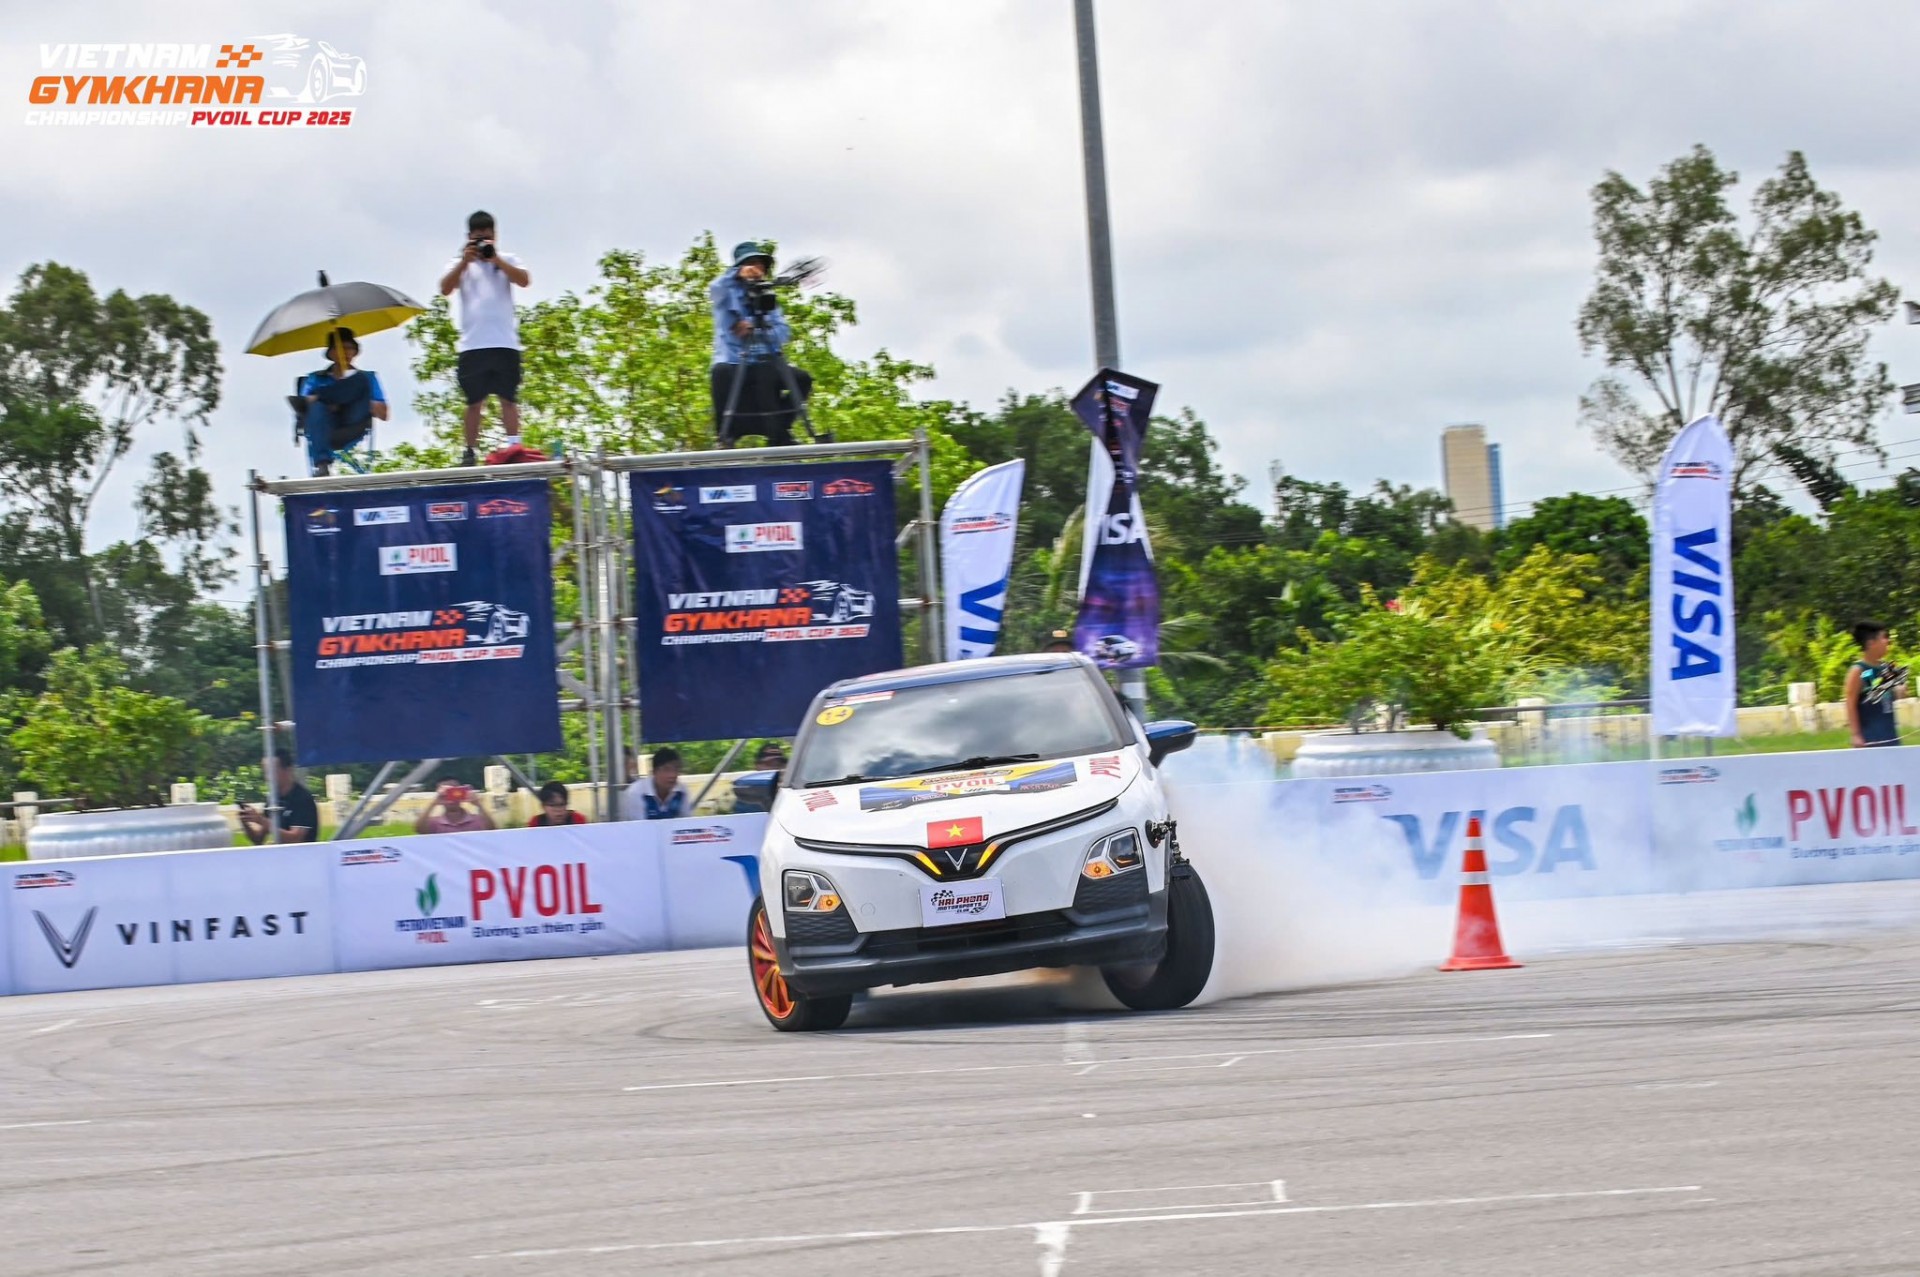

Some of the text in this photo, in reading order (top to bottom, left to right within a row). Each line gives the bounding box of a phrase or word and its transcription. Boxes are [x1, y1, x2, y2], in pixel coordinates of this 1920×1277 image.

[1100, 513, 1143, 545] ISA
[668, 589, 779, 609] VIETNAM
[1671, 528, 1722, 680] VISA
[322, 610, 433, 632] VIETNAM
[663, 607, 812, 632] GYMKHANA
[959, 572, 1008, 657] VI
[318, 628, 466, 656] GYMKHANA
[661, 632, 765, 645] CHAMPIONSHIP
[808, 628, 835, 638] CUP
[315, 654, 419, 669] CHAMPIONSHIP
[463, 648, 489, 659] CUP
[935, 778, 999, 791] PVOIL
[1787, 784, 1918, 842] PVOIL
[1381, 804, 1597, 880] VSA
[470, 863, 603, 920] PVOIL
[938, 898, 955, 906] HAI
[117, 911, 308, 945] VINFAST
